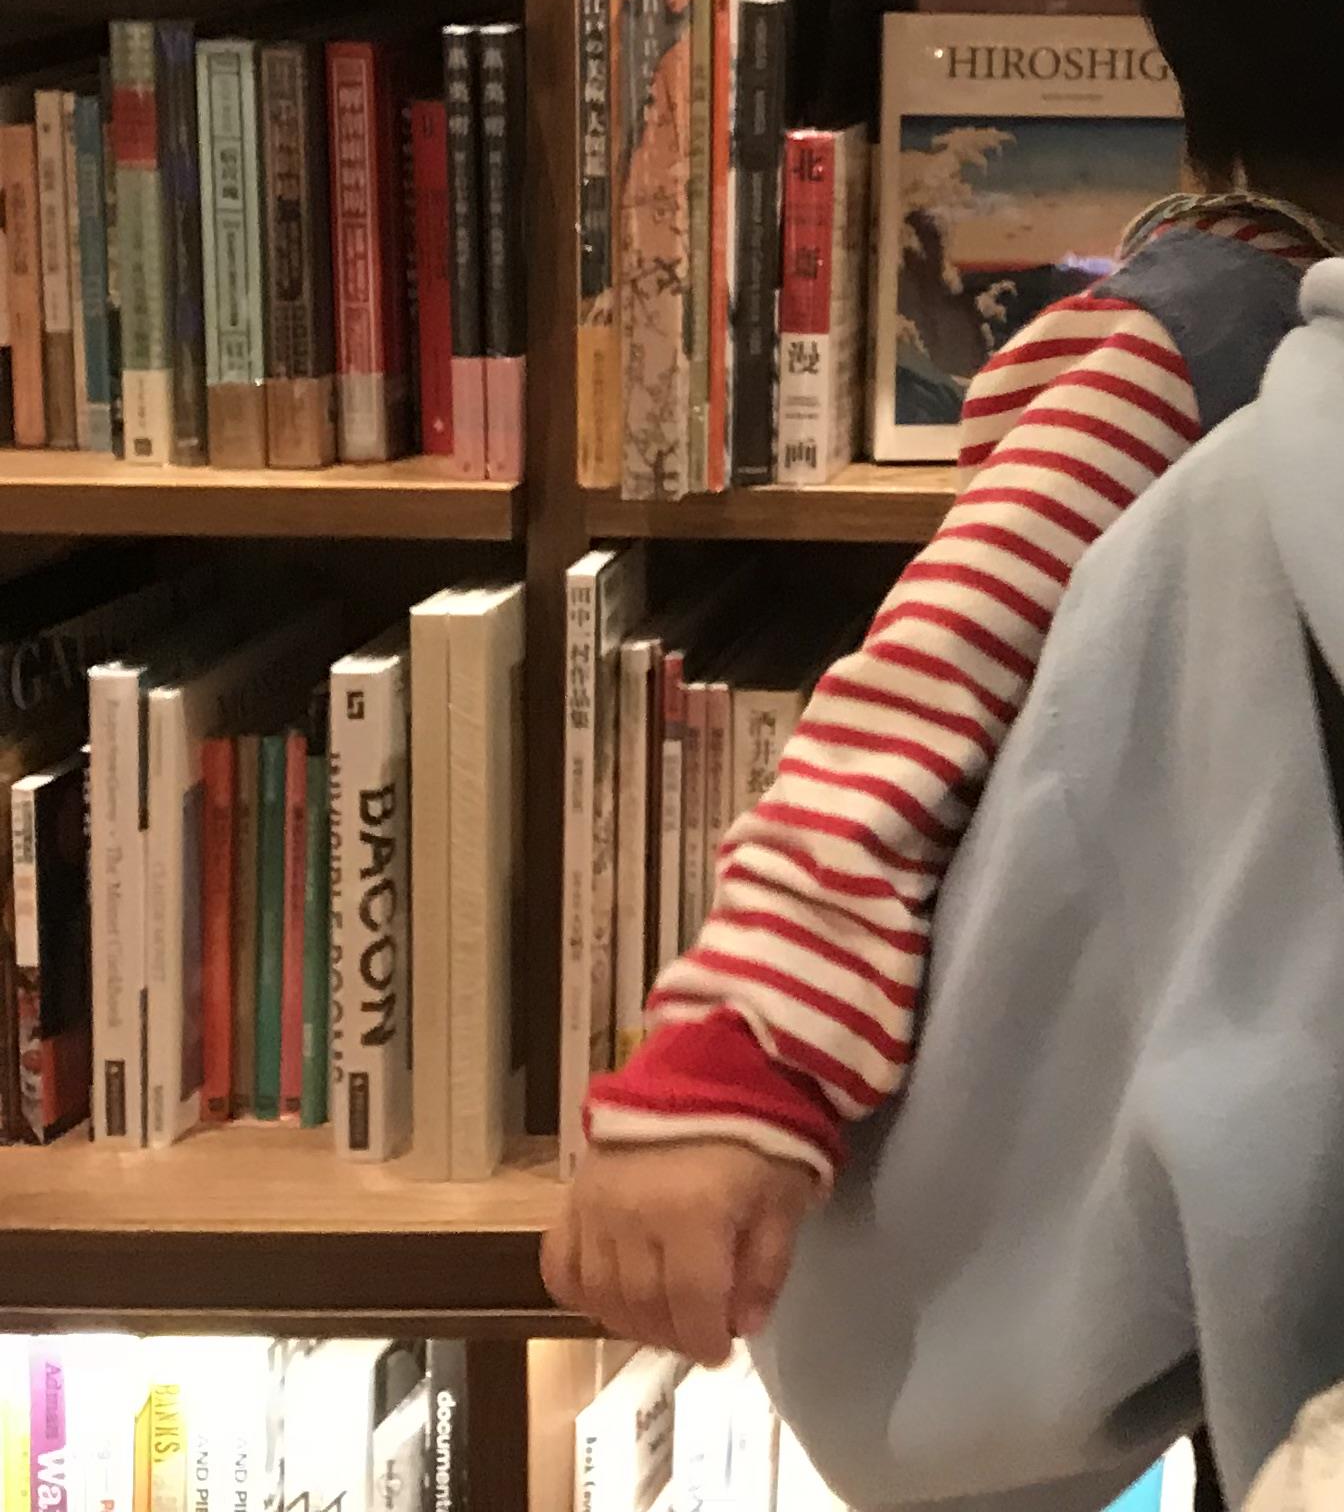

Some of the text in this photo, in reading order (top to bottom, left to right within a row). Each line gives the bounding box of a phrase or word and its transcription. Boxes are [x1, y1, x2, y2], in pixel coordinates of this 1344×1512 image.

[947, 45, 1169, 82] HIROSHIG
[359, 784, 397, 1048] BACON
[45, 1362, 62, 1440] Adman
